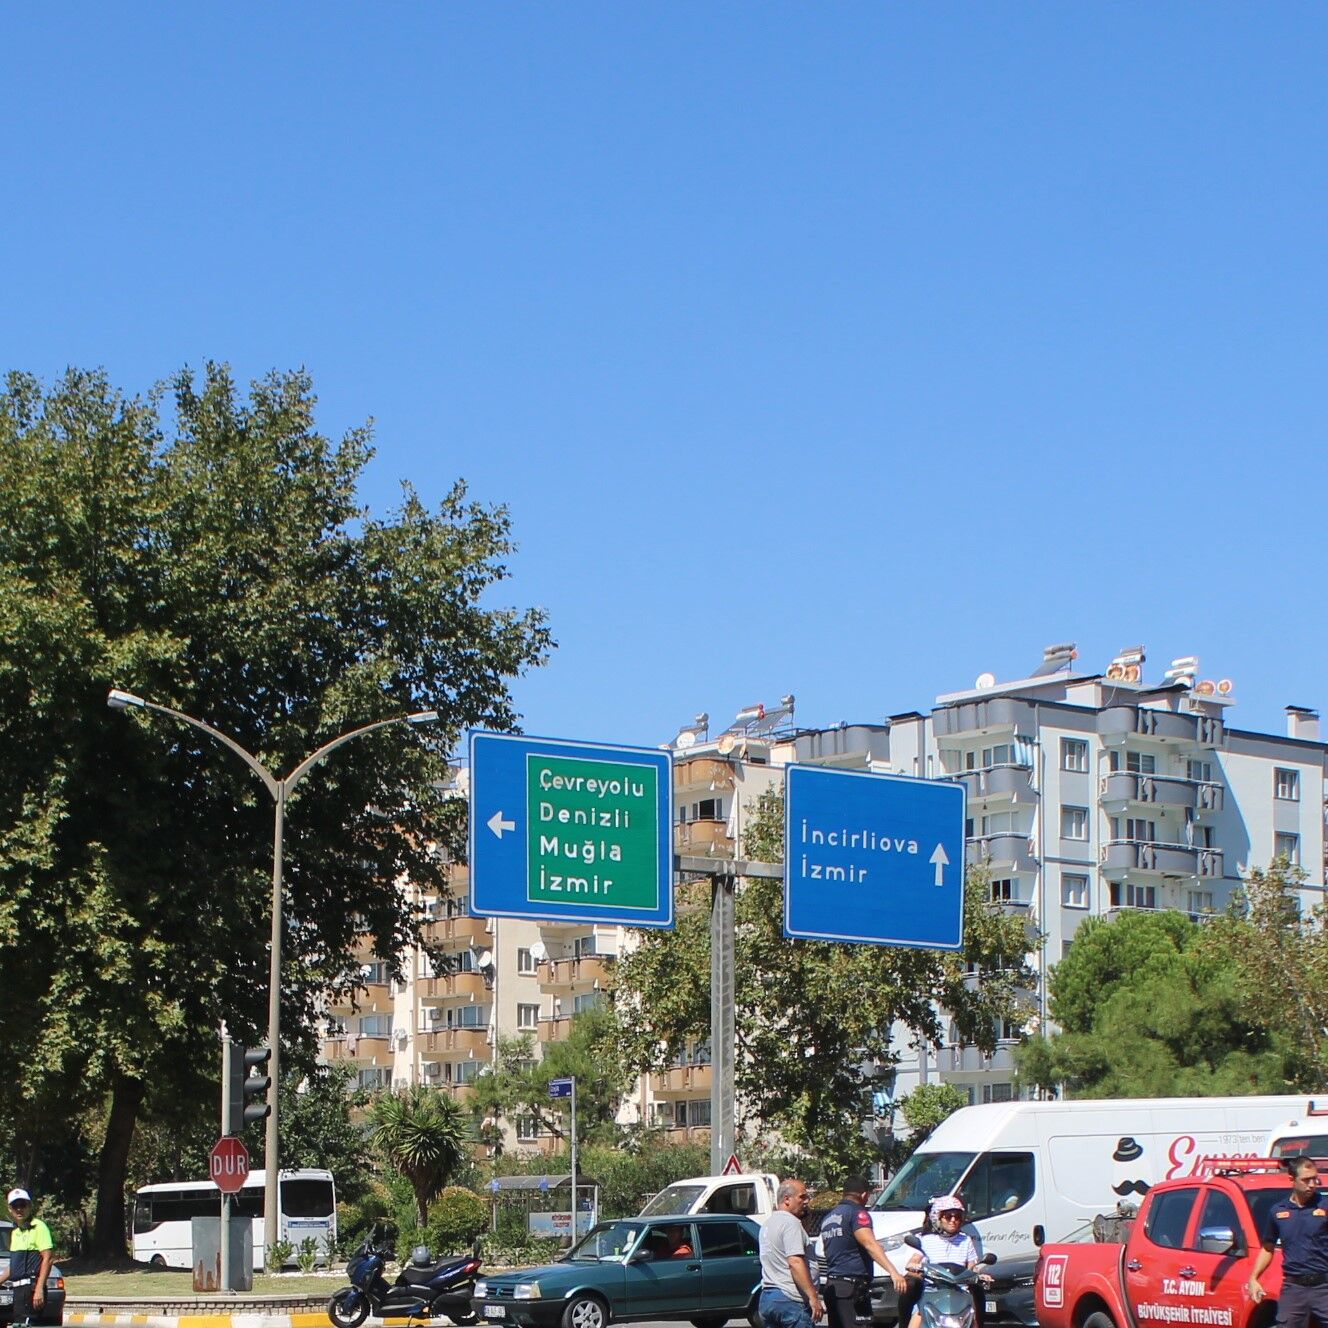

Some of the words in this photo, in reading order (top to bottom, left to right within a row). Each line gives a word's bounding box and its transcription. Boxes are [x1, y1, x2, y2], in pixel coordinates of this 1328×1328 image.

[539, 768, 644, 798] Çevreyolu
[540, 801, 629, 828] Denizli
[540, 834, 622, 864] Muğla
[802, 818, 918, 854] İncirliova
[540, 864, 613, 895] İzmir
[801, 853, 868, 884] İzmir
[213, 1154, 247, 1176] DUR
[1047, 1263, 1061, 1285] 112
[1163, 1279, 1178, 1295] T.C.
[1179, 1281, 1206, 1296] AYDIN
[1137, 1301, 1191, 1324] BÜYÜKŞEHİR
[1190, 1305, 1233, 1326] İTFAİYESİ
